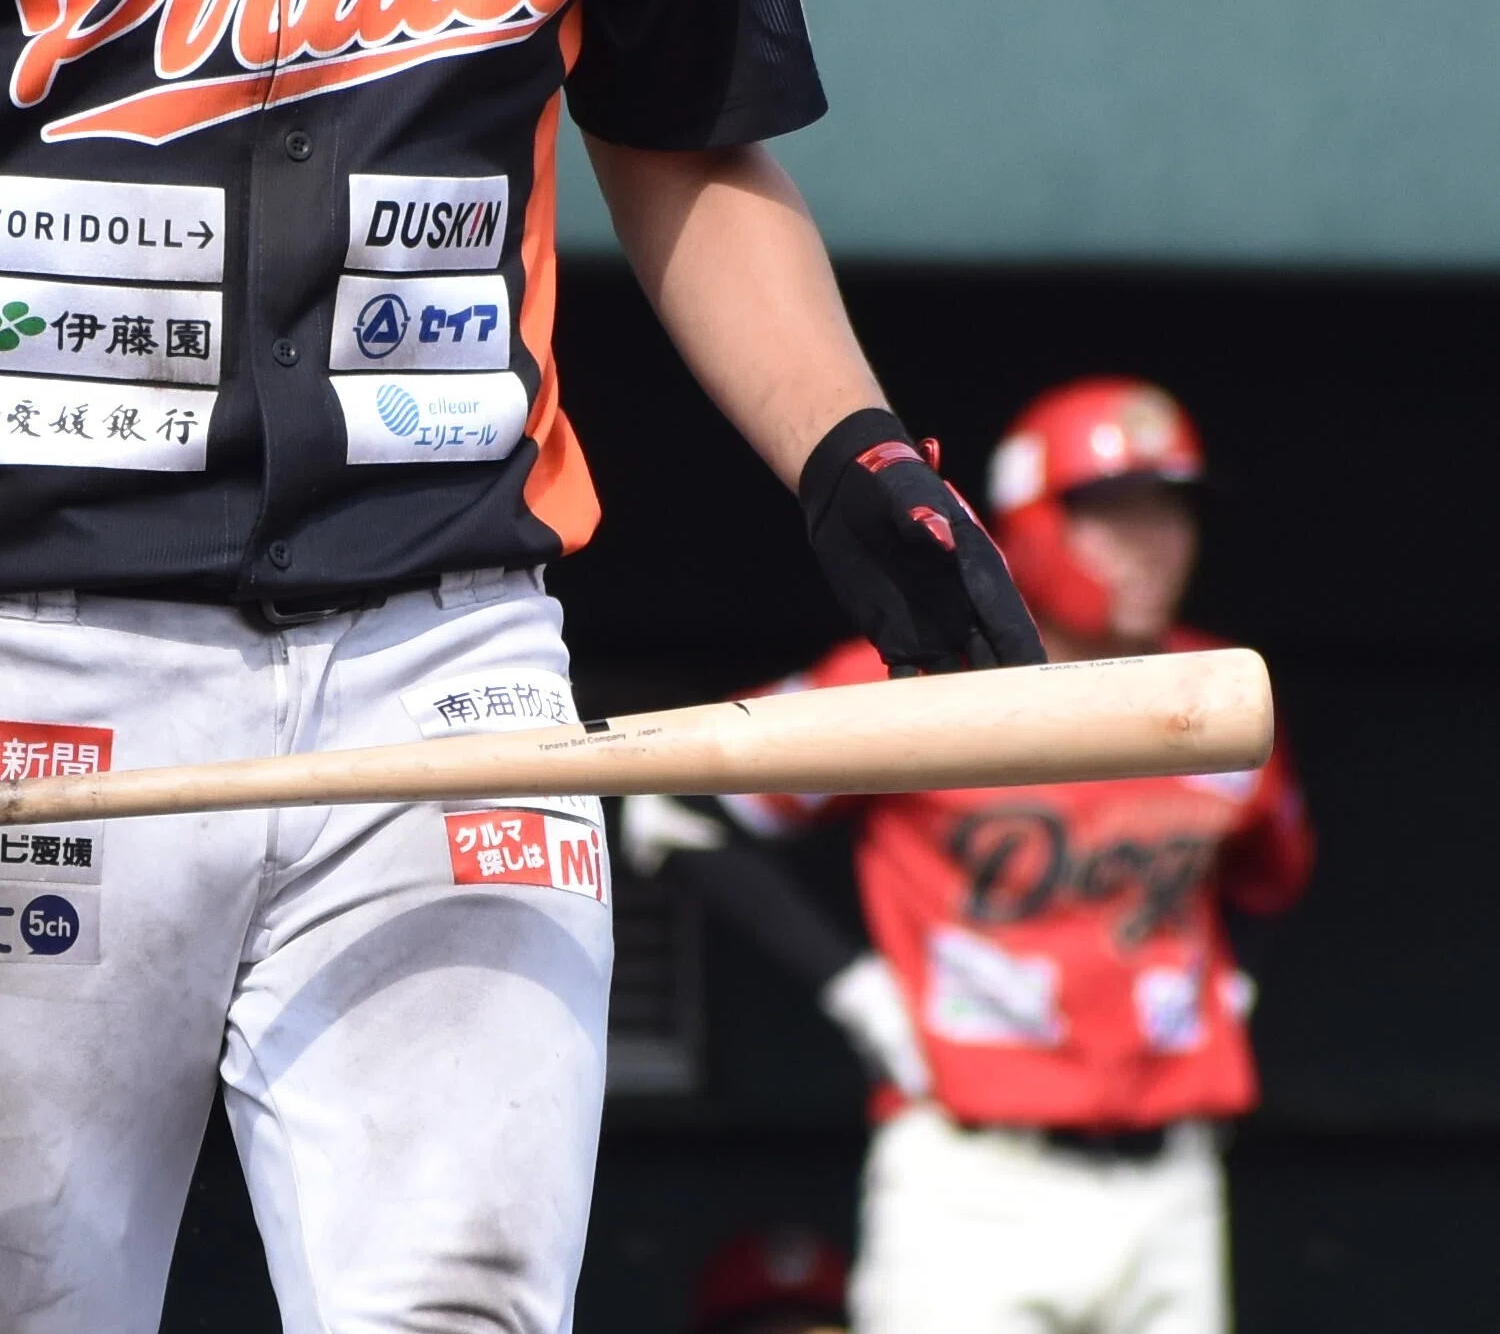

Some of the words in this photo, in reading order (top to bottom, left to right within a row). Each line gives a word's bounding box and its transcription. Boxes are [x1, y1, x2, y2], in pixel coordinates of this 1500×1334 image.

[50, 310, 212, 361] 伊藤園
[418, 304, 498, 343] セイア
[7, 399, 199, 446] 愛媛銀行
[414, 424, 498, 451] エリエール
[433, 683, 569, 727] 南海放送
[455, 819, 522, 853] クルマ
[477, 843, 545, 877] 探しは
[28, 910, 71, 938] 5ch
